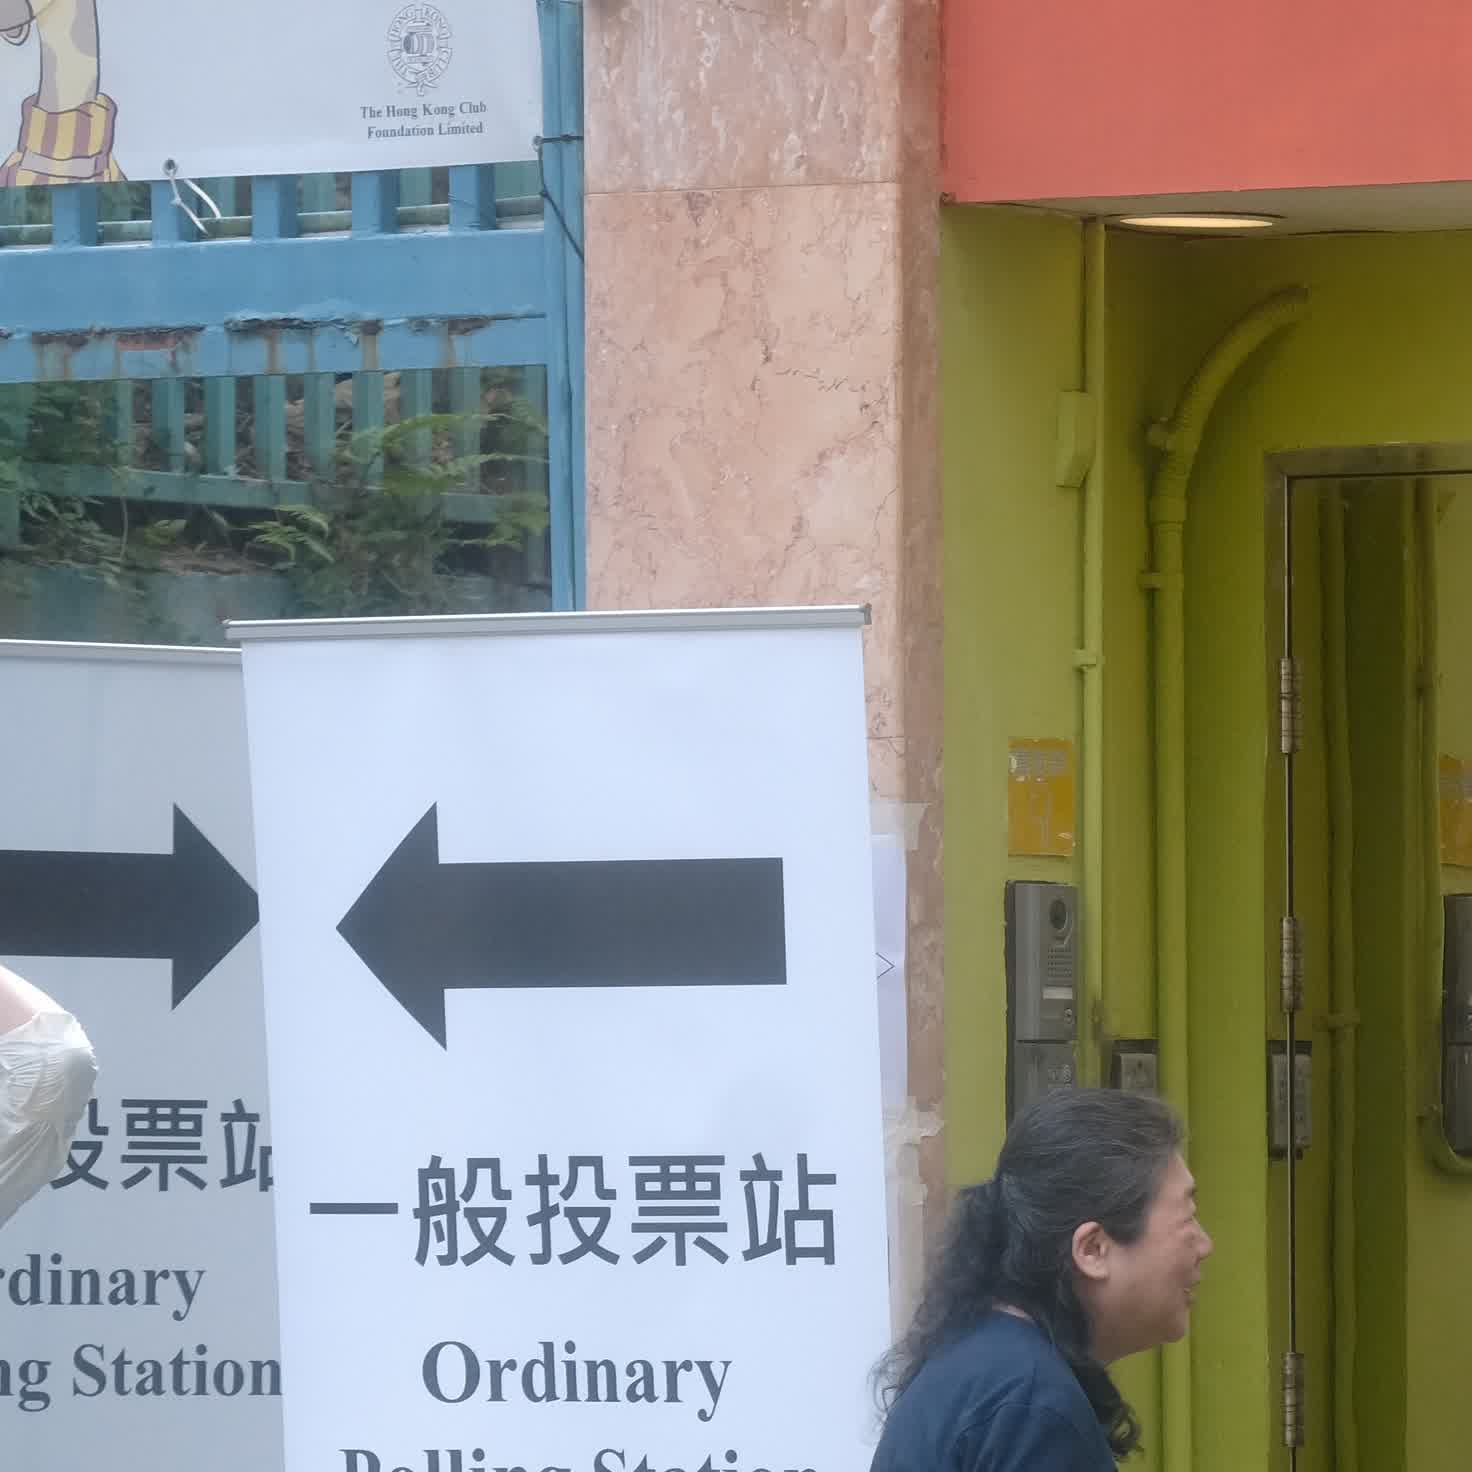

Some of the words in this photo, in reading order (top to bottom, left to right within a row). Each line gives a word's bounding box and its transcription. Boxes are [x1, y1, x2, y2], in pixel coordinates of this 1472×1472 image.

[360, 105, 383, 119] The
[386, 104, 418, 119] Hong
[422, 102, 456, 117] Kong
[459, 101, 488, 114] Club
[367, 125, 435, 139] Foundation
[438, 121, 484, 136] Limited
[309, 1152, 837, 1267] 一般投票站
[0, 1253, 207, 1322] dinary
[72, 1343, 283, 1398] Station
[421, 1341, 733, 1422] Ordinary
